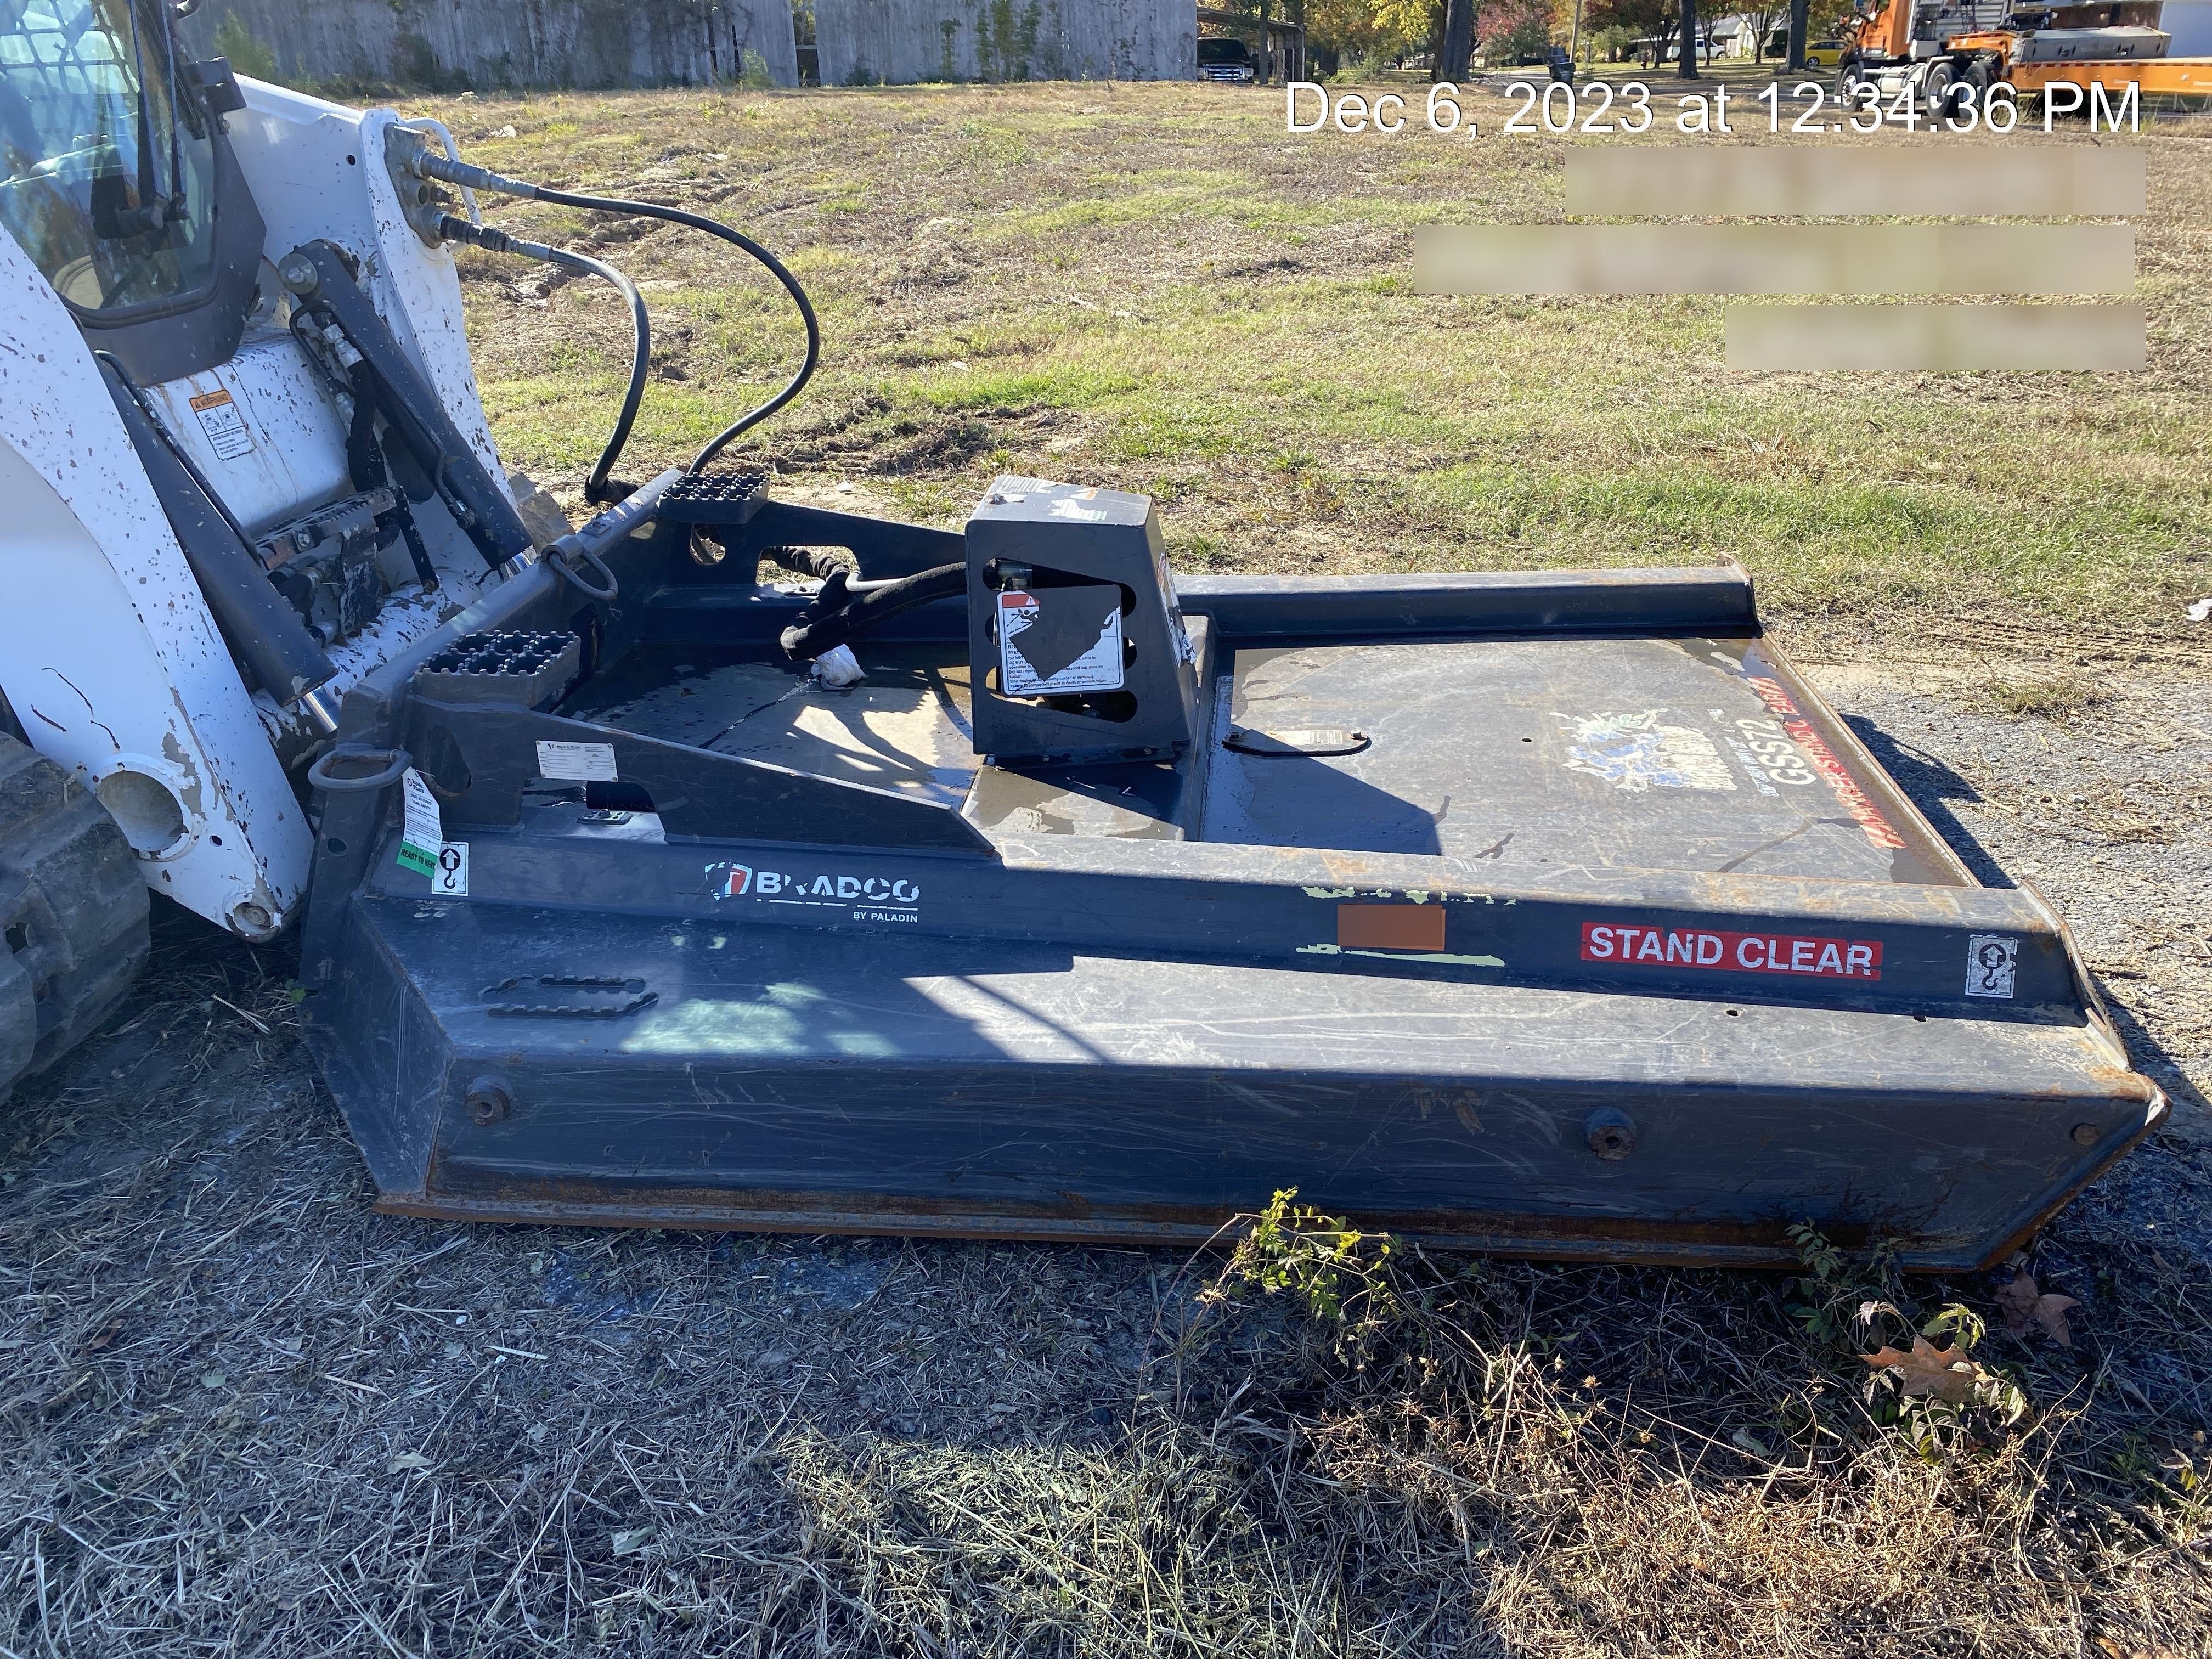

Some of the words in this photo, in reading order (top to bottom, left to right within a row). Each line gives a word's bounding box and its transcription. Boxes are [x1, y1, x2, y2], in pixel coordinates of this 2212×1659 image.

[1735, 719, 1816, 785] GSS72
[400, 848, 417, 861] READY
[418, 855, 424, 864] TO
[424, 859, 436, 870] RENT
[853, 911, 867, 919] BY
[871, 912, 918, 923] PALADIN
[1589, 926, 1724, 966] STAND
[1736, 937, 1874, 977] CLEAR
